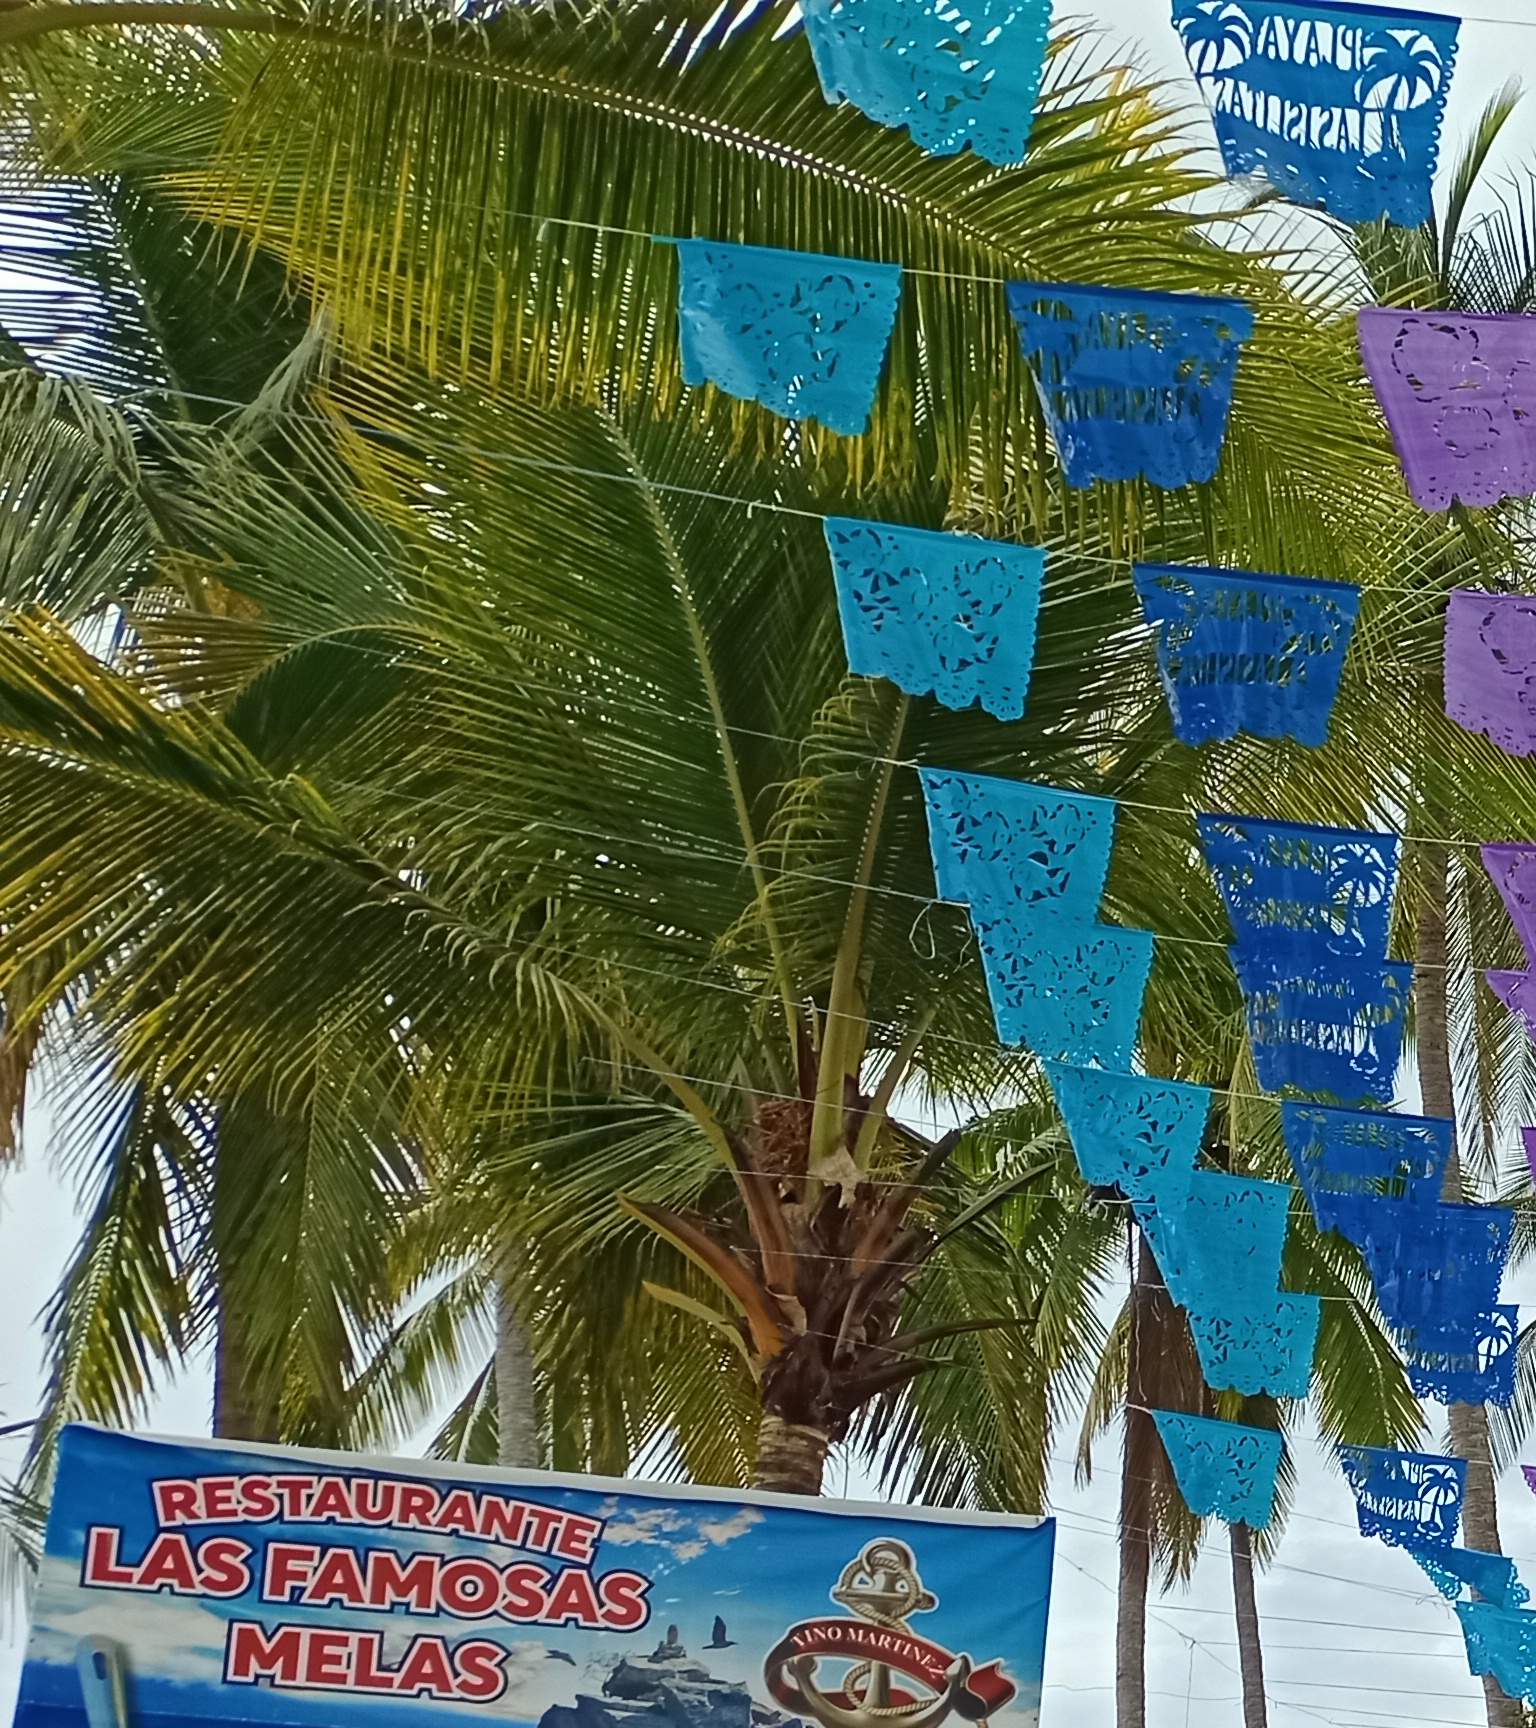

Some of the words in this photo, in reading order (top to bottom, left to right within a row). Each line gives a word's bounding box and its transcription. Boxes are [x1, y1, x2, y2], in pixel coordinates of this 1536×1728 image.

[154, 1476, 603, 1564] RESTAURANTE
[84, 1526, 250, 1597] LAS
[262, 1541, 650, 1631] FAMOSAS
[226, 1622, 507, 1700] MELAS
[790, 1625, 843, 1649] TINO
[848, 1626, 946, 1681] MARTINEZ
